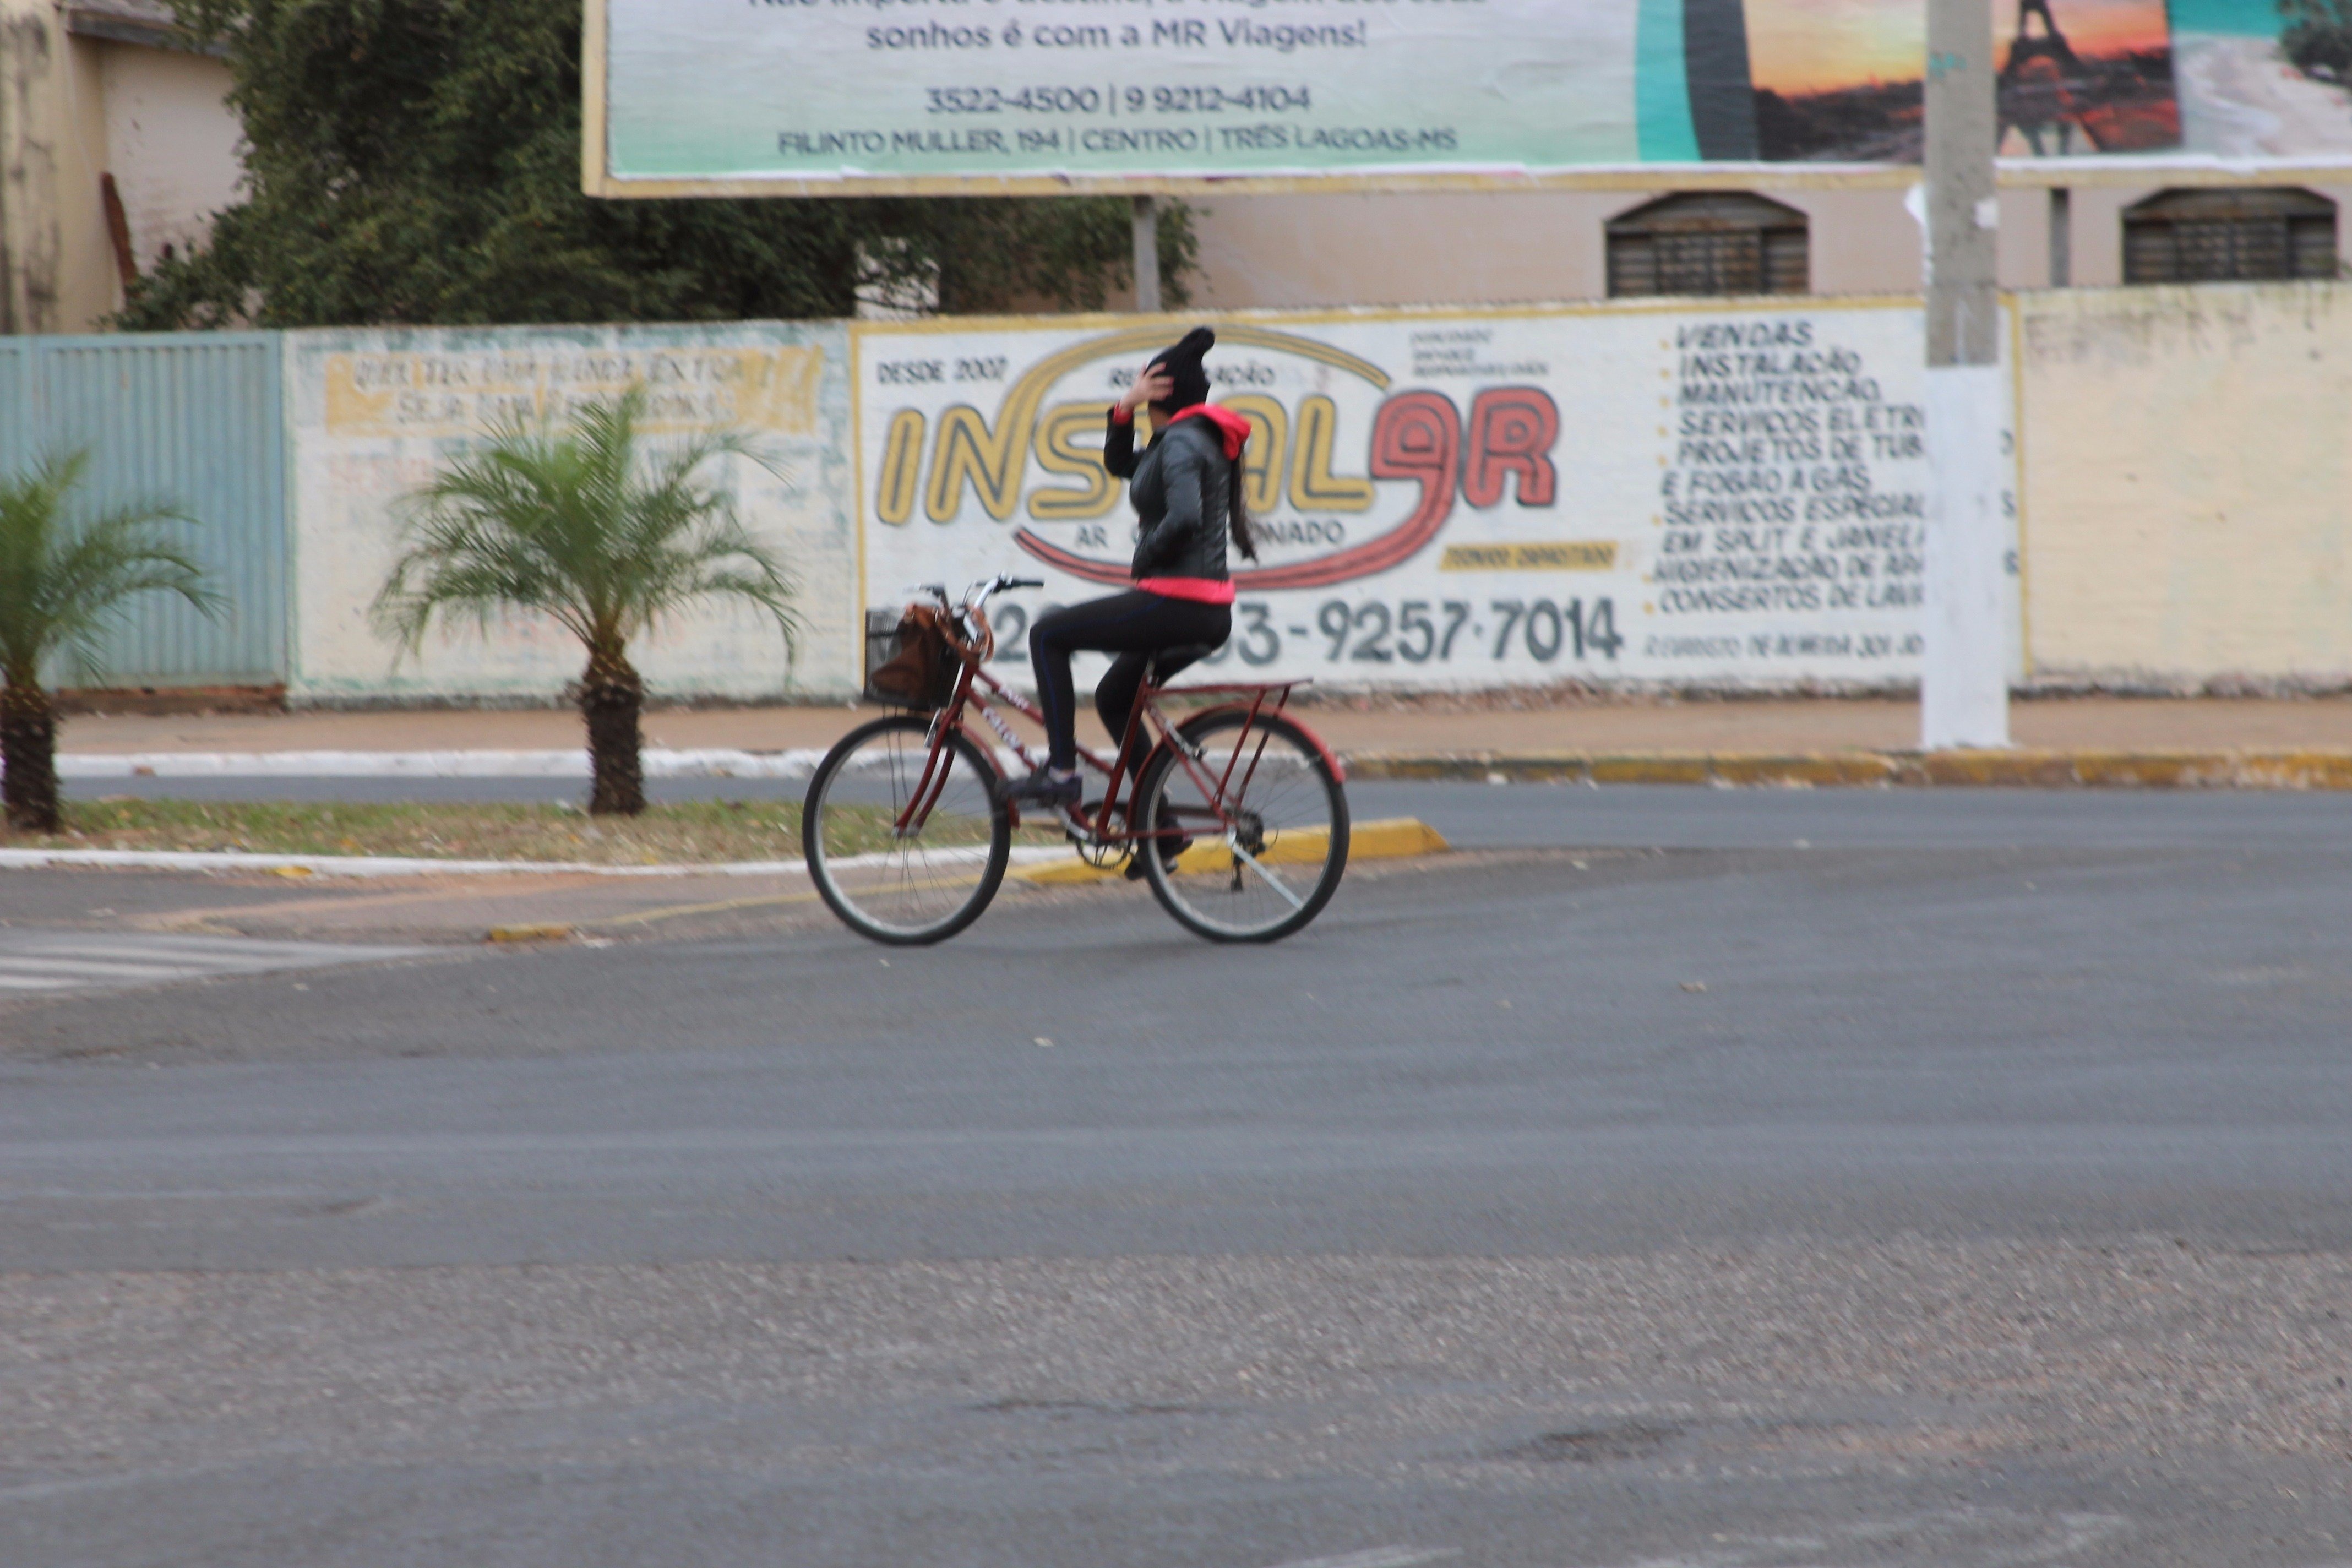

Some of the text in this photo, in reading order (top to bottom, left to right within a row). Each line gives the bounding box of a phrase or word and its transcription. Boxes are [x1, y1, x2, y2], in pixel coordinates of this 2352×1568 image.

[866, 18, 1366, 53] sonhos é com a MR Viagens!
[926, 86, 1100, 113] 3522-4500
[1125, 86, 1145, 112] 9
[1155, 86, 1311, 112] 9212-4104
[777, 130, 883, 156] FILINTO
[1017, 129, 1060, 152] 194
[1081, 127, 1199, 151] CENTRO
[1217, 122, 1288, 150] TRÊS
[1294, 126, 1459, 150] LAGOAS-MS
[1675, 322, 1815, 349] VENDAS
[876, 359, 945, 384] DESDE
[1075, 523, 1107, 549] AR
[1662, 527, 1702, 555] EM
